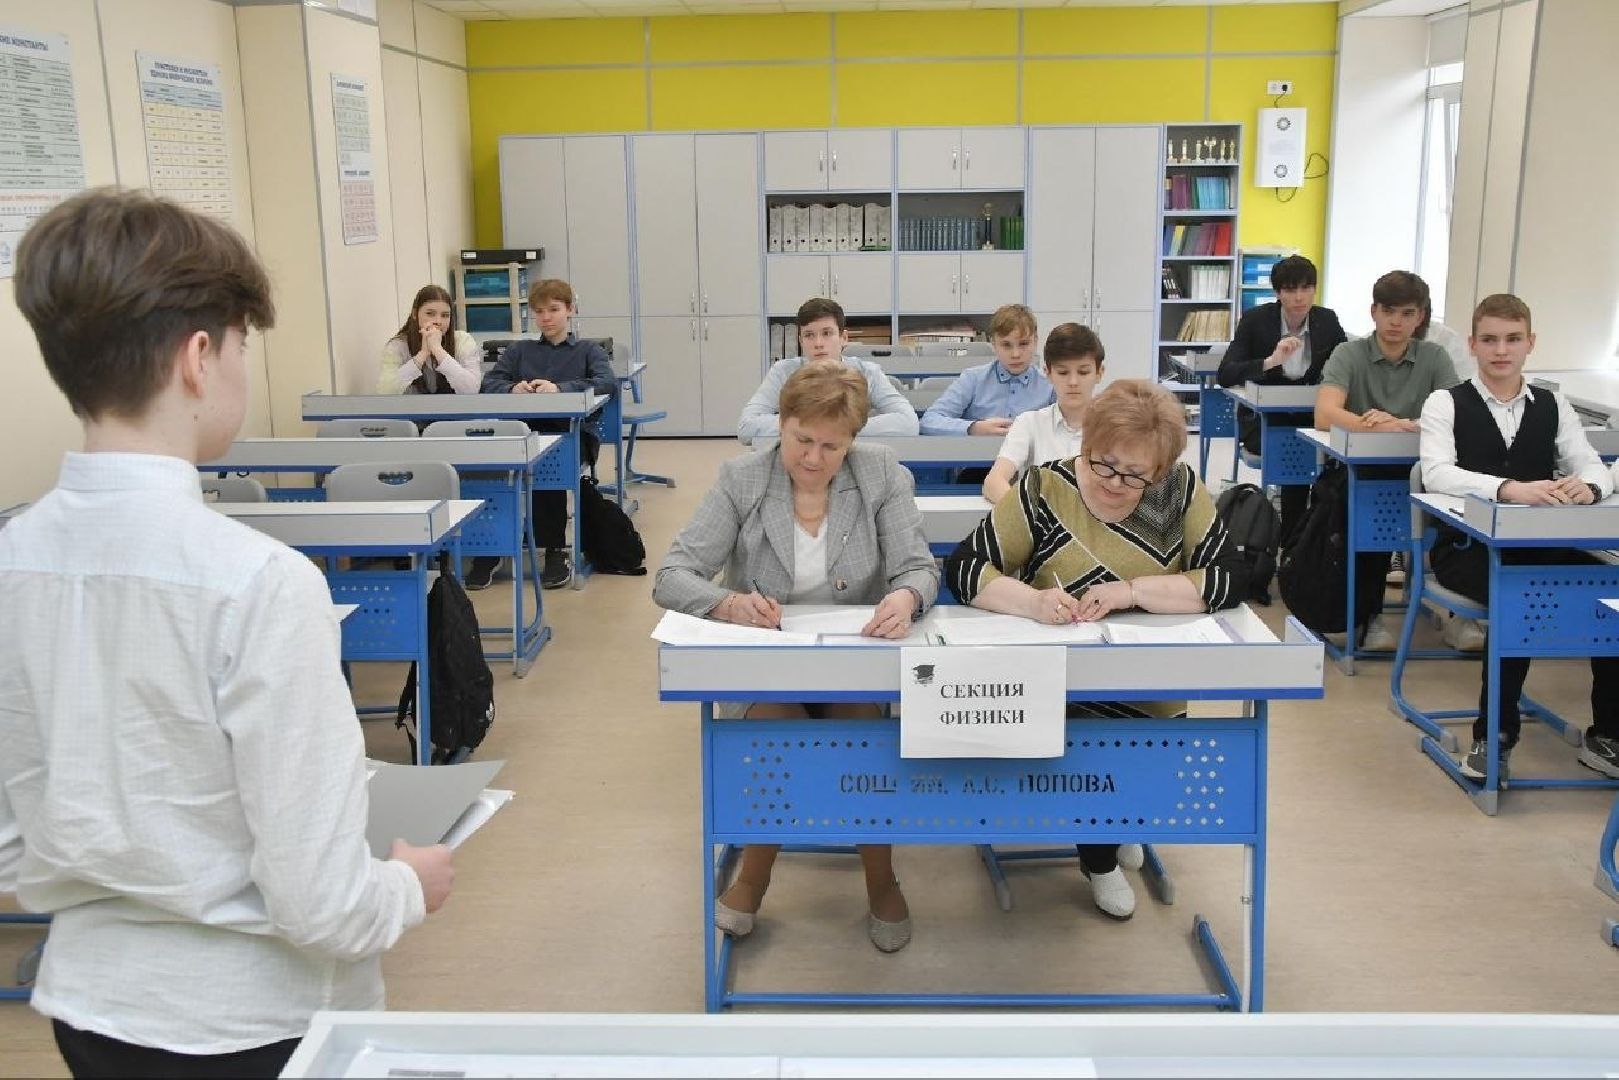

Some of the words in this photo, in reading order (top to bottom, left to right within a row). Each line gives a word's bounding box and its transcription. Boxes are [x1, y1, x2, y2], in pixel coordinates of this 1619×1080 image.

[940, 683, 1024, 700] СЕКЦИЯ
[940, 709, 1025, 725] ФИЗИКИ
[1018, 774, 1115, 793] ПОПОВА
